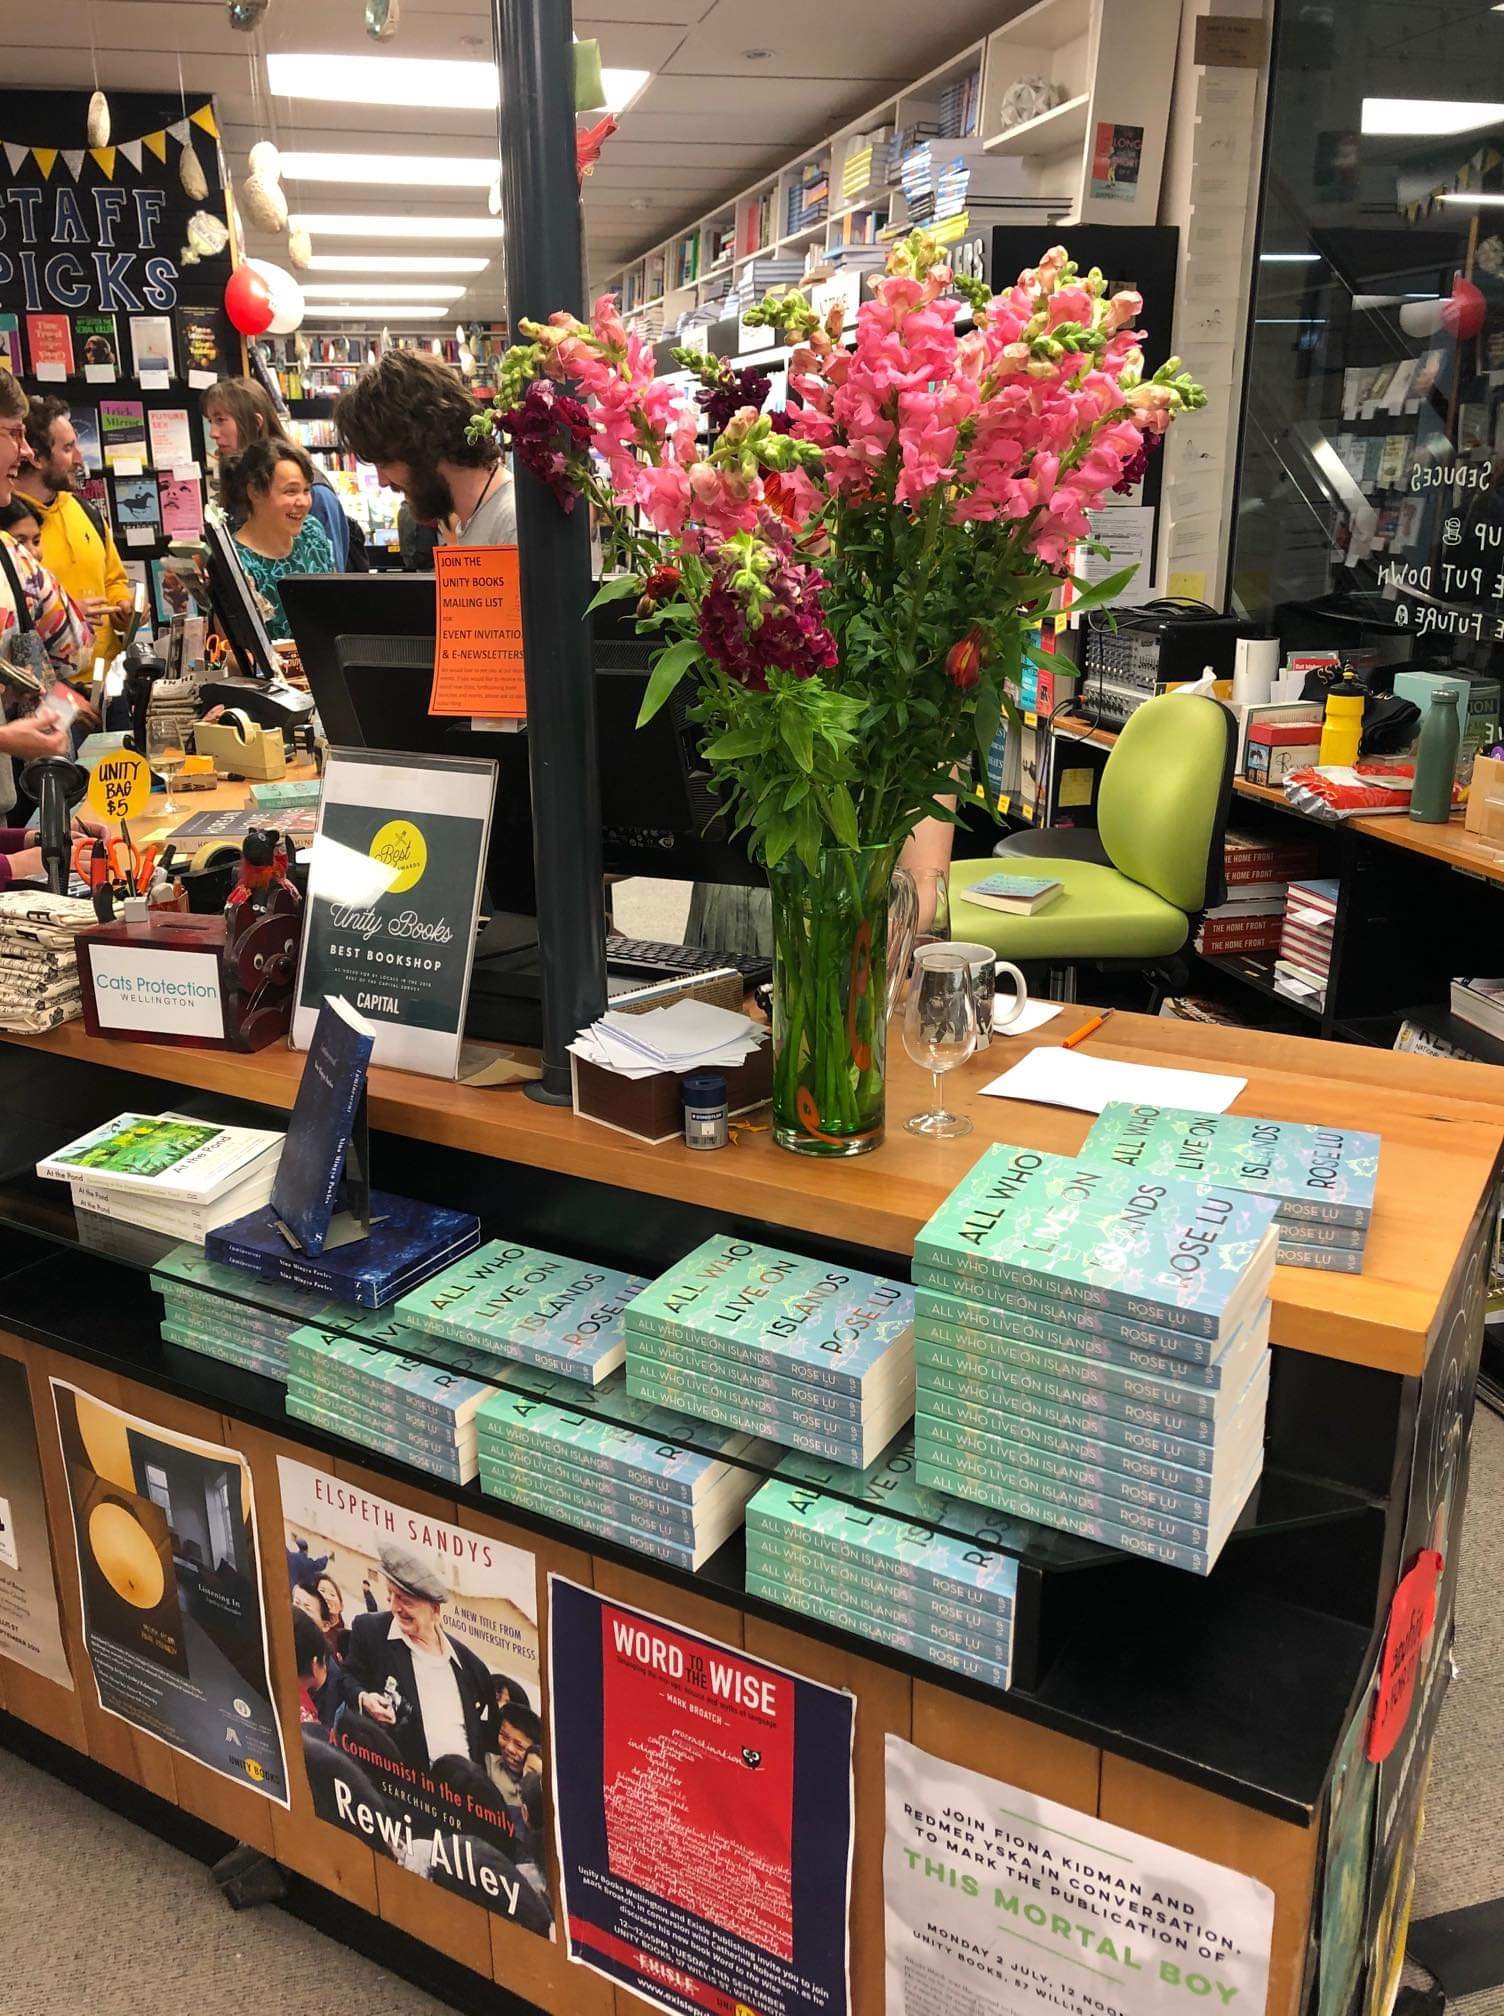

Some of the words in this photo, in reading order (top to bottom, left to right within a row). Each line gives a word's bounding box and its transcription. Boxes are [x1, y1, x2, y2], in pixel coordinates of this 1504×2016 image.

[0, 187, 166, 250] TAFF
[441, 557, 462, 568] JOIN
[464, 557, 482, 566] THE
[442, 578, 470, 588] UNITY
[473, 577, 504, 588] BOOKS
[443, 599, 483, 608] MAILING
[485, 598, 504, 608] LIST
[442, 650, 449, 660] &
[443, 630, 472, 640] EVENT
[99, 761, 142, 782] UNITY
[105, 783, 132, 800] BAG
[106, 799, 128, 817] $5
[330, 902, 383, 941] Unity
[388, 910, 454, 944] Books
[1212, 942, 1224, 950] THE
[1225, 940, 1243, 950] HOME
[1244, 938, 1265, 948] FRONT
[1213, 924, 1225, 933] THE
[1226, 923, 1244, 932] HOME
[1246, 922, 1266, 930] FRONT
[330, 944, 360, 958] BEST
[367, 950, 442, 972] BOOKSHOP
[96, 974, 132, 992] Cats
[138, 976, 218, 1000] Protection
[121, 993, 196, 1008] WELLINGTON
[356, 992, 400, 1014] CAPITAL
[1127, 1107, 1162, 1140] WHO
[1175, 1138, 1206, 1170] LIVE
[1195, 1117, 1220, 1138] ON
[67, 1172, 84, 1182] Pond
[1112, 1138, 1148, 1168] ALL
[1240, 1124, 1282, 1181] ISLANDS
[1307, 1147, 1336, 1190] ROSE
[1325, 1132, 1344, 1152] LU
[958, 1209, 1005, 1246] ALL
[986, 1154, 1043, 1202] WHO
[1060, 1172, 1104, 1204] ON
[1206, 1198, 1234, 1228] LU
[663, 1284, 710, 1314] ALL
[696, 1244, 753, 1282] WHO
[715, 1285, 770, 1323] LIVE
[760, 1260, 800, 1287] ON
[932, 1252, 953, 1266] ALL
[956, 1258, 989, 1276] WHO
[992, 1266, 1019, 1282] LIVE
[1022, 1274, 1043, 1290] ON
[1046, 1281, 1100, 1304] ISLANDS
[1128, 1302, 1164, 1320] ROSE
[1168, 1311, 1186, 1325] LU
[766, 1272, 850, 1338] ISLANDS
[820, 1308, 882, 1354] ROSE
[874, 1286, 902, 1308] LU
[315, 1478, 396, 1532] ELSPETH
[408, 1520, 494, 1568] SANDYS
[443, 1614, 468, 1634] OTAGO
[469, 1624, 511, 1650] UNIVERSITY
[513, 1642, 536, 1662] PRESS
[454, 1606, 460, 1616] A
[462, 1608, 478, 1624] NEW
[480, 1614, 497, 1631] TITLE
[500, 1624, 522, 1641] FROM
[613, 1620, 683, 1678] WORD
[690, 1654, 704, 1672] TO
[686, 1668, 708, 1690] THE
[710, 1661, 776, 1717] WISE
[667, 1693, 687, 1711] MARK
[689, 1701, 722, 1726] BROATCH
[328, 1728, 338, 1745] A
[342, 1735, 417, 1784] Communist
[421, 1773, 435, 1794] in
[440, 1782, 462, 1808] the
[467, 1794, 515, 1838] Family
[382, 1781, 438, 1818] SEARCHING
[444, 1813, 462, 1832] FOR
[334, 1778, 414, 1857] Rewi
[431, 1829, 520, 1916] Alley
[904, 1803, 975, 1844] REDMER
[984, 1840, 1032, 1870] YSKA
[1041, 1866, 1060, 1882] IN
[942, 1808, 985, 1832] JOIN
[995, 1828, 1053, 1862] FIONA
[1062, 1856, 1142, 1896] KIDMAN
[1152, 1892, 1195, 1916] AND
[915, 1827, 938, 1844] TO
[946, 1841, 998, 1870] MARK
[1006, 1866, 1041, 1890] THE
[1051, 1886, 1188, 1951] PUBLICATION
[1198, 1946, 1226, 1963] OF
[578, 1866, 600, 1880] Unity
[600, 1874, 624, 1893] Books
[626, 1888, 668, 1914] Wellington
[670, 1912, 685, 1922] and
[712, 1931, 756, 1962] Publishing
[758, 1954, 781, 1973] invite
[783, 1969, 800, 1984] you
[801, 1978, 811, 1990] to
[812, 1983, 830, 2000] join
[583, 1878, 604, 1892] Mark
[638, 1904, 645, 1913] in
[692, 1932, 710, 1946] with
[712, 1942, 751, 1968] Catherine
[904, 1848, 979, 1898] THIS
[994, 1888, 1142, 1970] MORTAL
[1160, 1960, 1240, 2006] BOY
[670, 1944, 710, 1971] TUESDAY
[732, 1978, 786, 2012] SEPTEMBER
[914, 1930, 952, 1955] UNITY
[958, 1953, 1008, 1984] BOOKS,
[1014, 1980, 1030, 1991] 57
[928, 1922, 990, 1958] MONDAY
[996, 1956, 1004, 1966] 2
[1010, 1963, 1053, 1988] JULY,
[1062, 1984, 1076, 1996] 12
[1083, 1994, 1124, 2016] NOO
